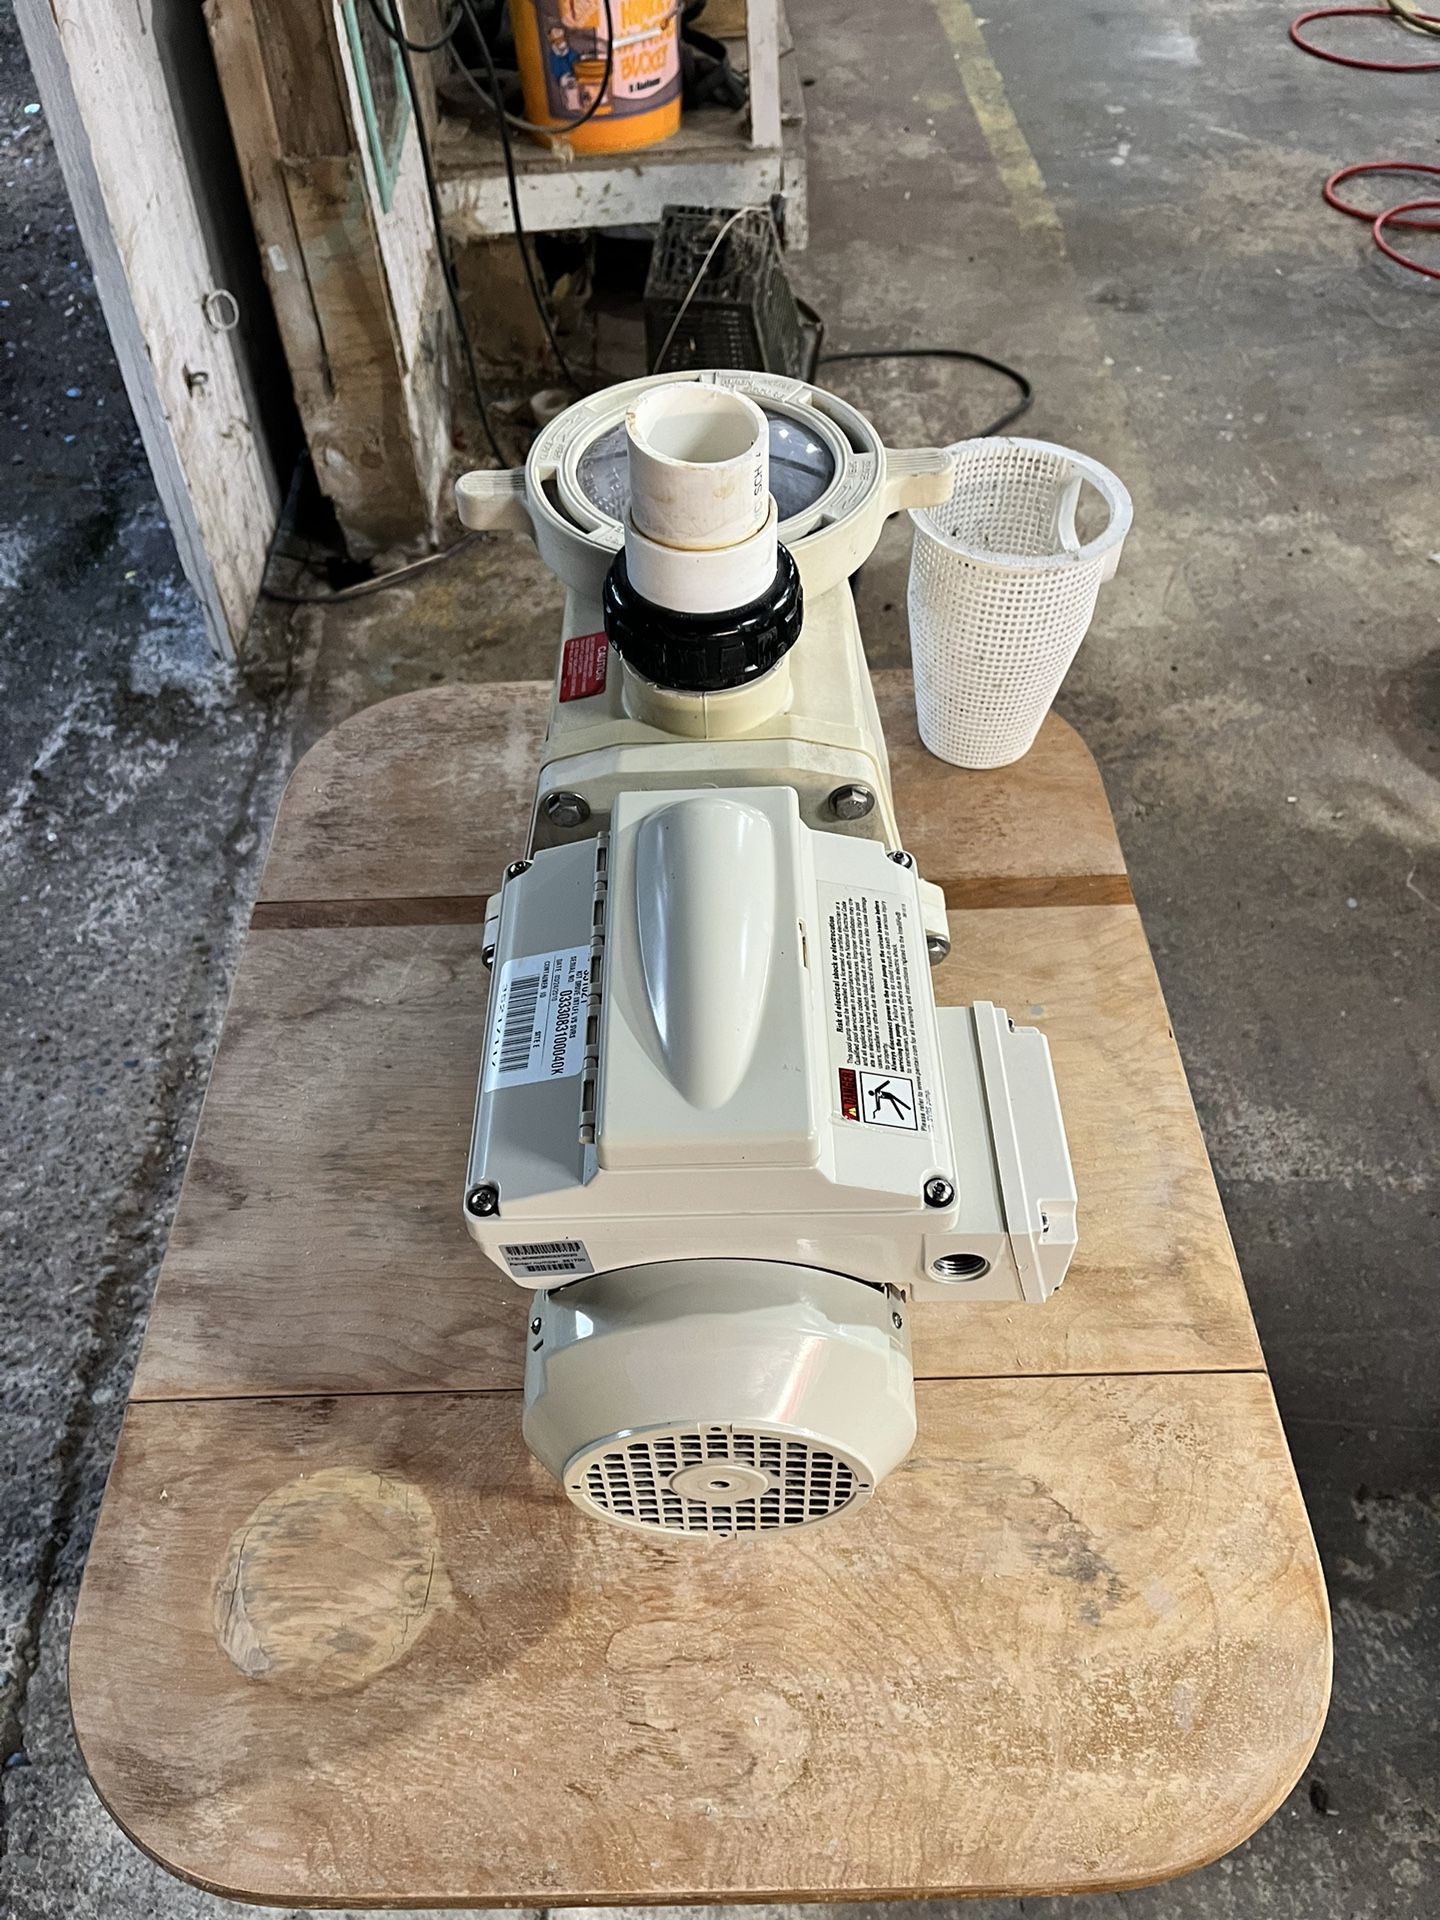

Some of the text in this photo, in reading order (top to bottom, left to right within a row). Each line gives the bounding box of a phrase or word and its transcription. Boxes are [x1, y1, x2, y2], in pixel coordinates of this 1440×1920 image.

[754, 464, 762, 496] SCH
[595, 645, 606, 681] CAUTION
[541, 961, 550, 989] CONTAINER
[568, 956, 577, 974] SERIAL
[833, 981, 842, 1010] electrical
[551, 990, 573, 1076] 0333083100040K
[840, 1069, 856, 1105] DANGER
